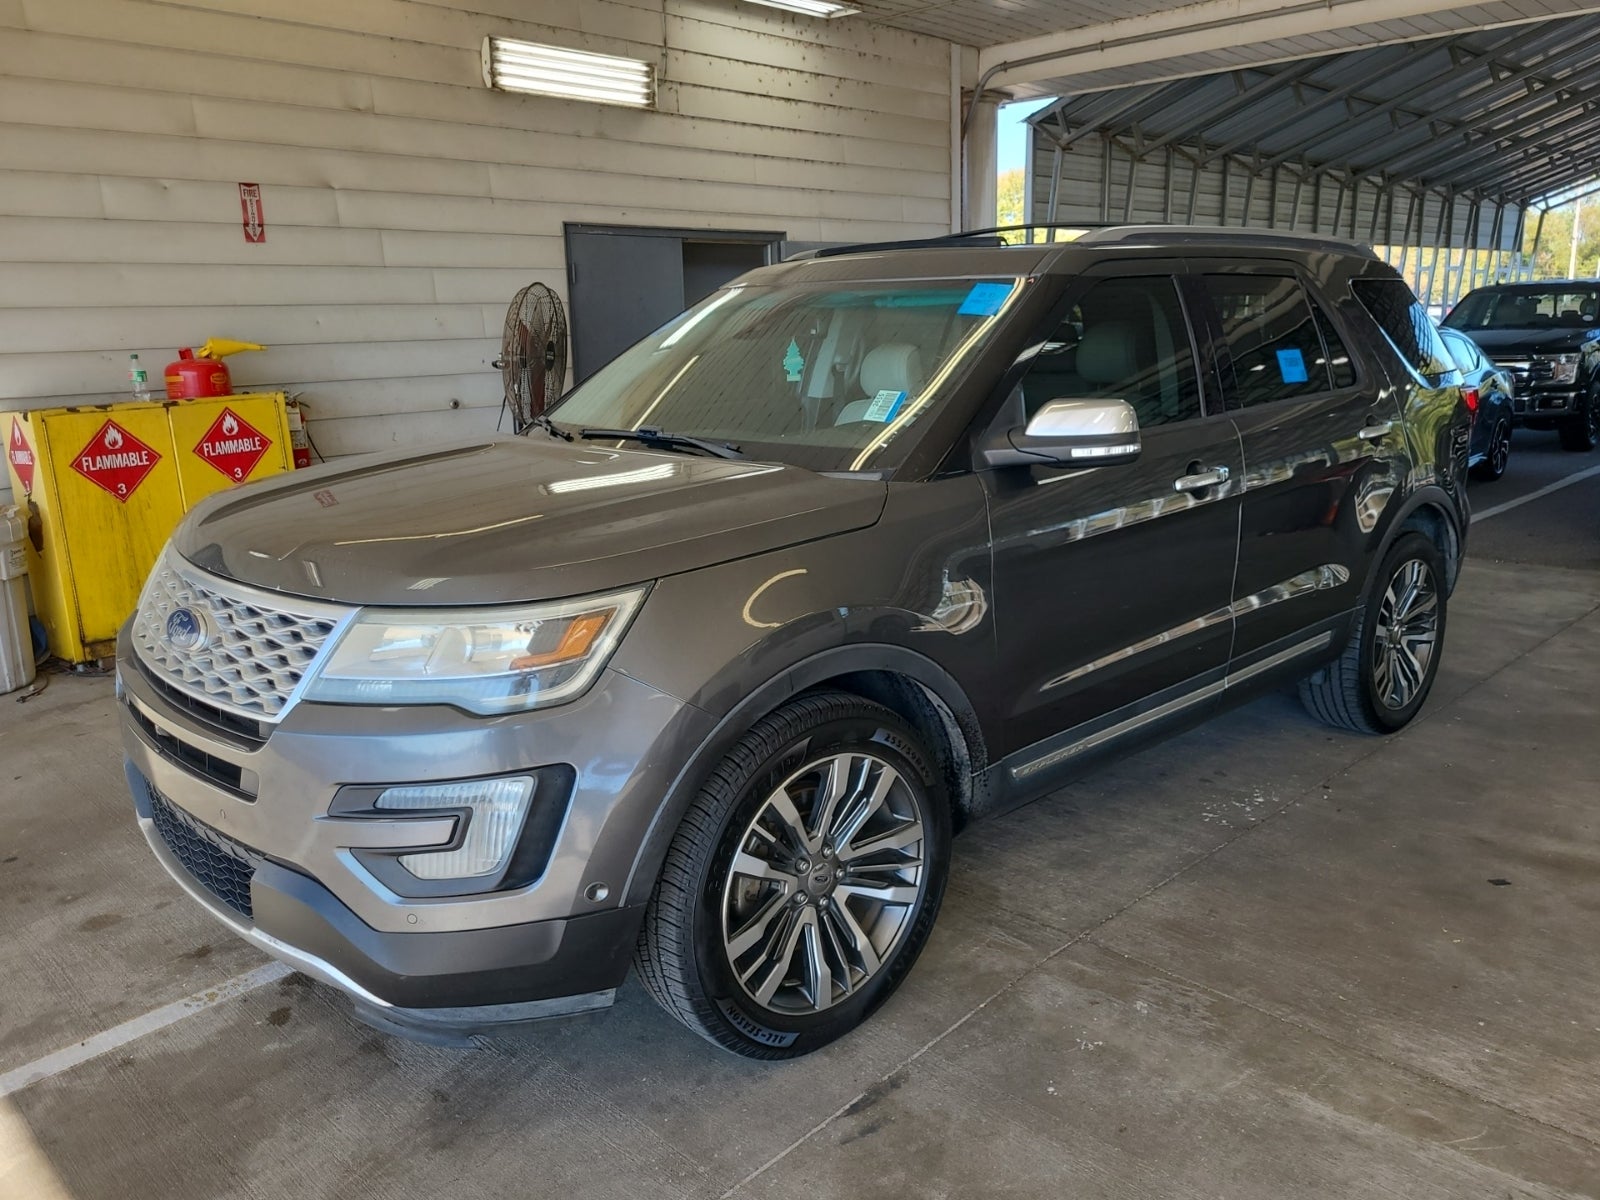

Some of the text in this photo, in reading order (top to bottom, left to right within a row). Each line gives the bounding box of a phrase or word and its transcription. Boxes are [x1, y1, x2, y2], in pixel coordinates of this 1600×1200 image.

[243, 188, 258, 198] FIRE
[203, 437, 262, 457] FLAMMABLE
[82, 451, 150, 472] FLAMMABLE
[234, 467, 242, 479] 3
[117, 483, 127, 494] 3
[169, 611, 192, 641] Ford
[727, 1006, 787, 1044] ALL-SEASON
